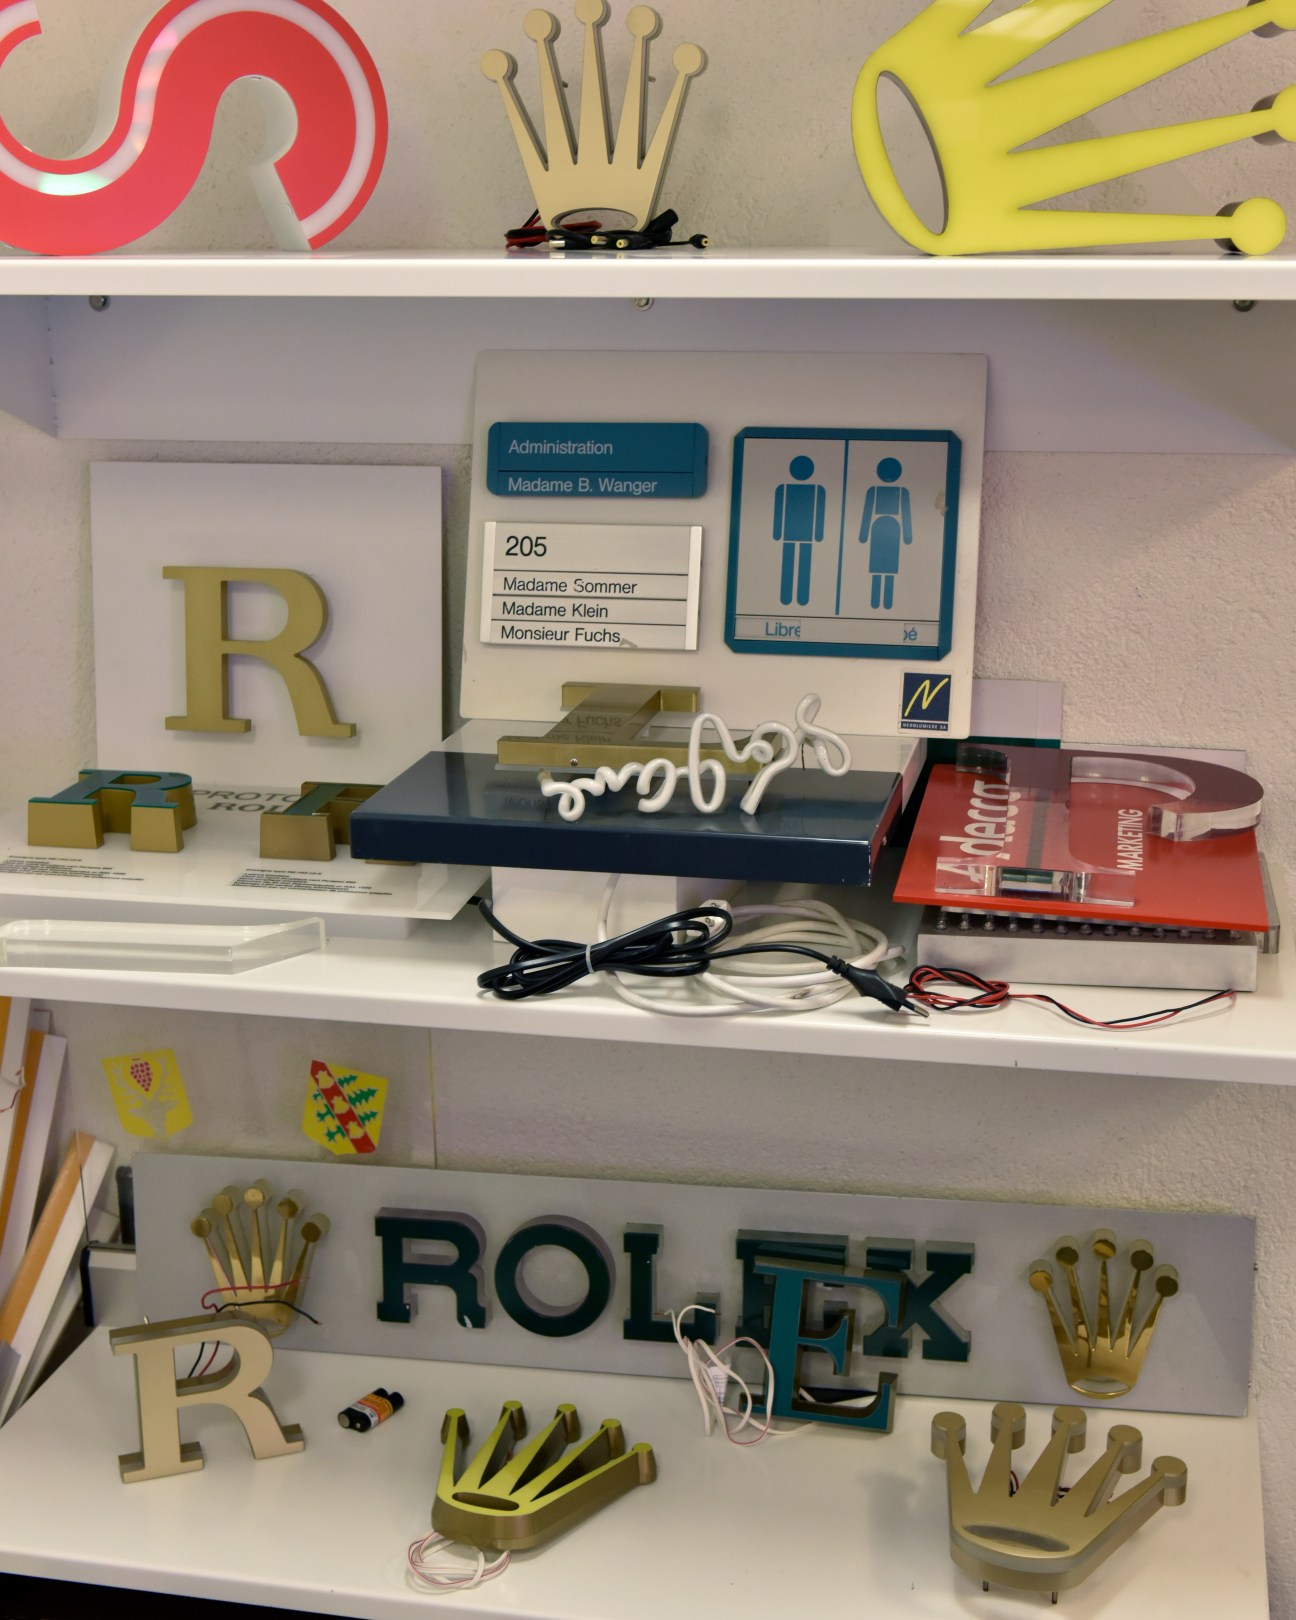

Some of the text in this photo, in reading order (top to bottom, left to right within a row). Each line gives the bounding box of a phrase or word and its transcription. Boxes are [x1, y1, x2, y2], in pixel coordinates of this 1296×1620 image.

[508, 439, 613, 455] Administration
[508, 477, 658, 495] Madame B. Wanger
[505, 535, 547, 557] 205
[503, 577, 637, 594] Madame Sommer
[502, 601, 609, 618] Madame Klein
[501, 625, 621, 643] Monsieur Fuchs
[162, 565, 357, 738] R
[1117, 808, 1144, 871] MARKETING
[109, 1311, 305, 1483] R
